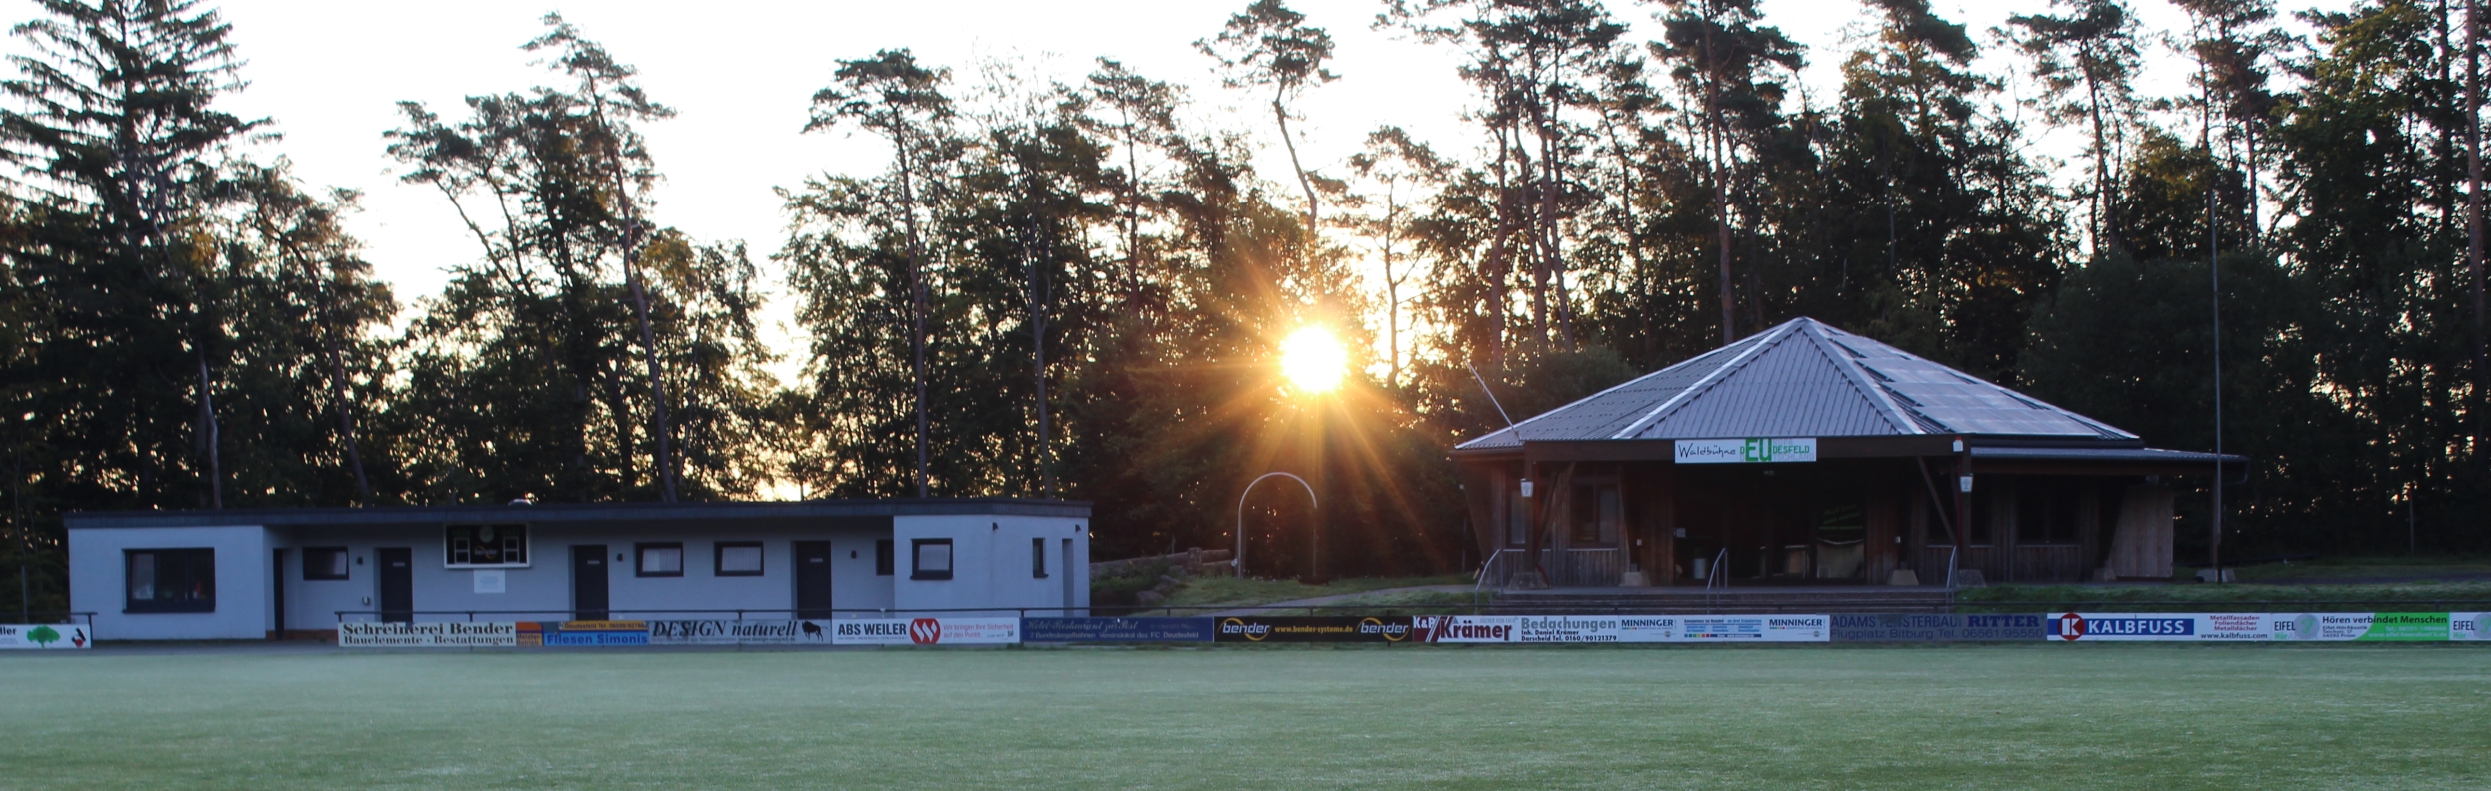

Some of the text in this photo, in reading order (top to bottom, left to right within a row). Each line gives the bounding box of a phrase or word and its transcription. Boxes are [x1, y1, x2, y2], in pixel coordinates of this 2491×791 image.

[1678, 443, 1736, 458] Waldbühne
[1521, 616, 1617, 632] Bedachungen
[1621, 619, 1673, 627] MINNINGER
[1769, 619, 1822, 627] MINNINGER
[1831, 616, 1876, 628] ADAMS
[1968, 615, 2039, 627] RITTER
[2322, 615, 2447, 624] Hören verbindet Menschen
[343, 623, 513, 635] Schreinerei Bender
[652, 620, 798, 637] DESIGN naturell
[838, 623, 907, 636] ABS WEILER
[953, 623, 975, 631] bringen
[1222, 622, 1270, 634] bender
[1274, 625, 1353, 634] www.bender-systeme.de
[1360, 622, 1409, 634] bender
[1440, 618, 1512, 641] Krämer
[2088, 620, 2184, 634] KALBFUSS
[2274, 621, 2296, 631] EIFEL
[2453, 621, 2475, 631] EIFEL
[547, 633, 648, 644] Fliesen Simonis
[1830, 628, 2043, 639] Flugplatz Bitburg Tel. 06561/95550
[344, 635, 514, 645] Bauelemente Bestattungen
